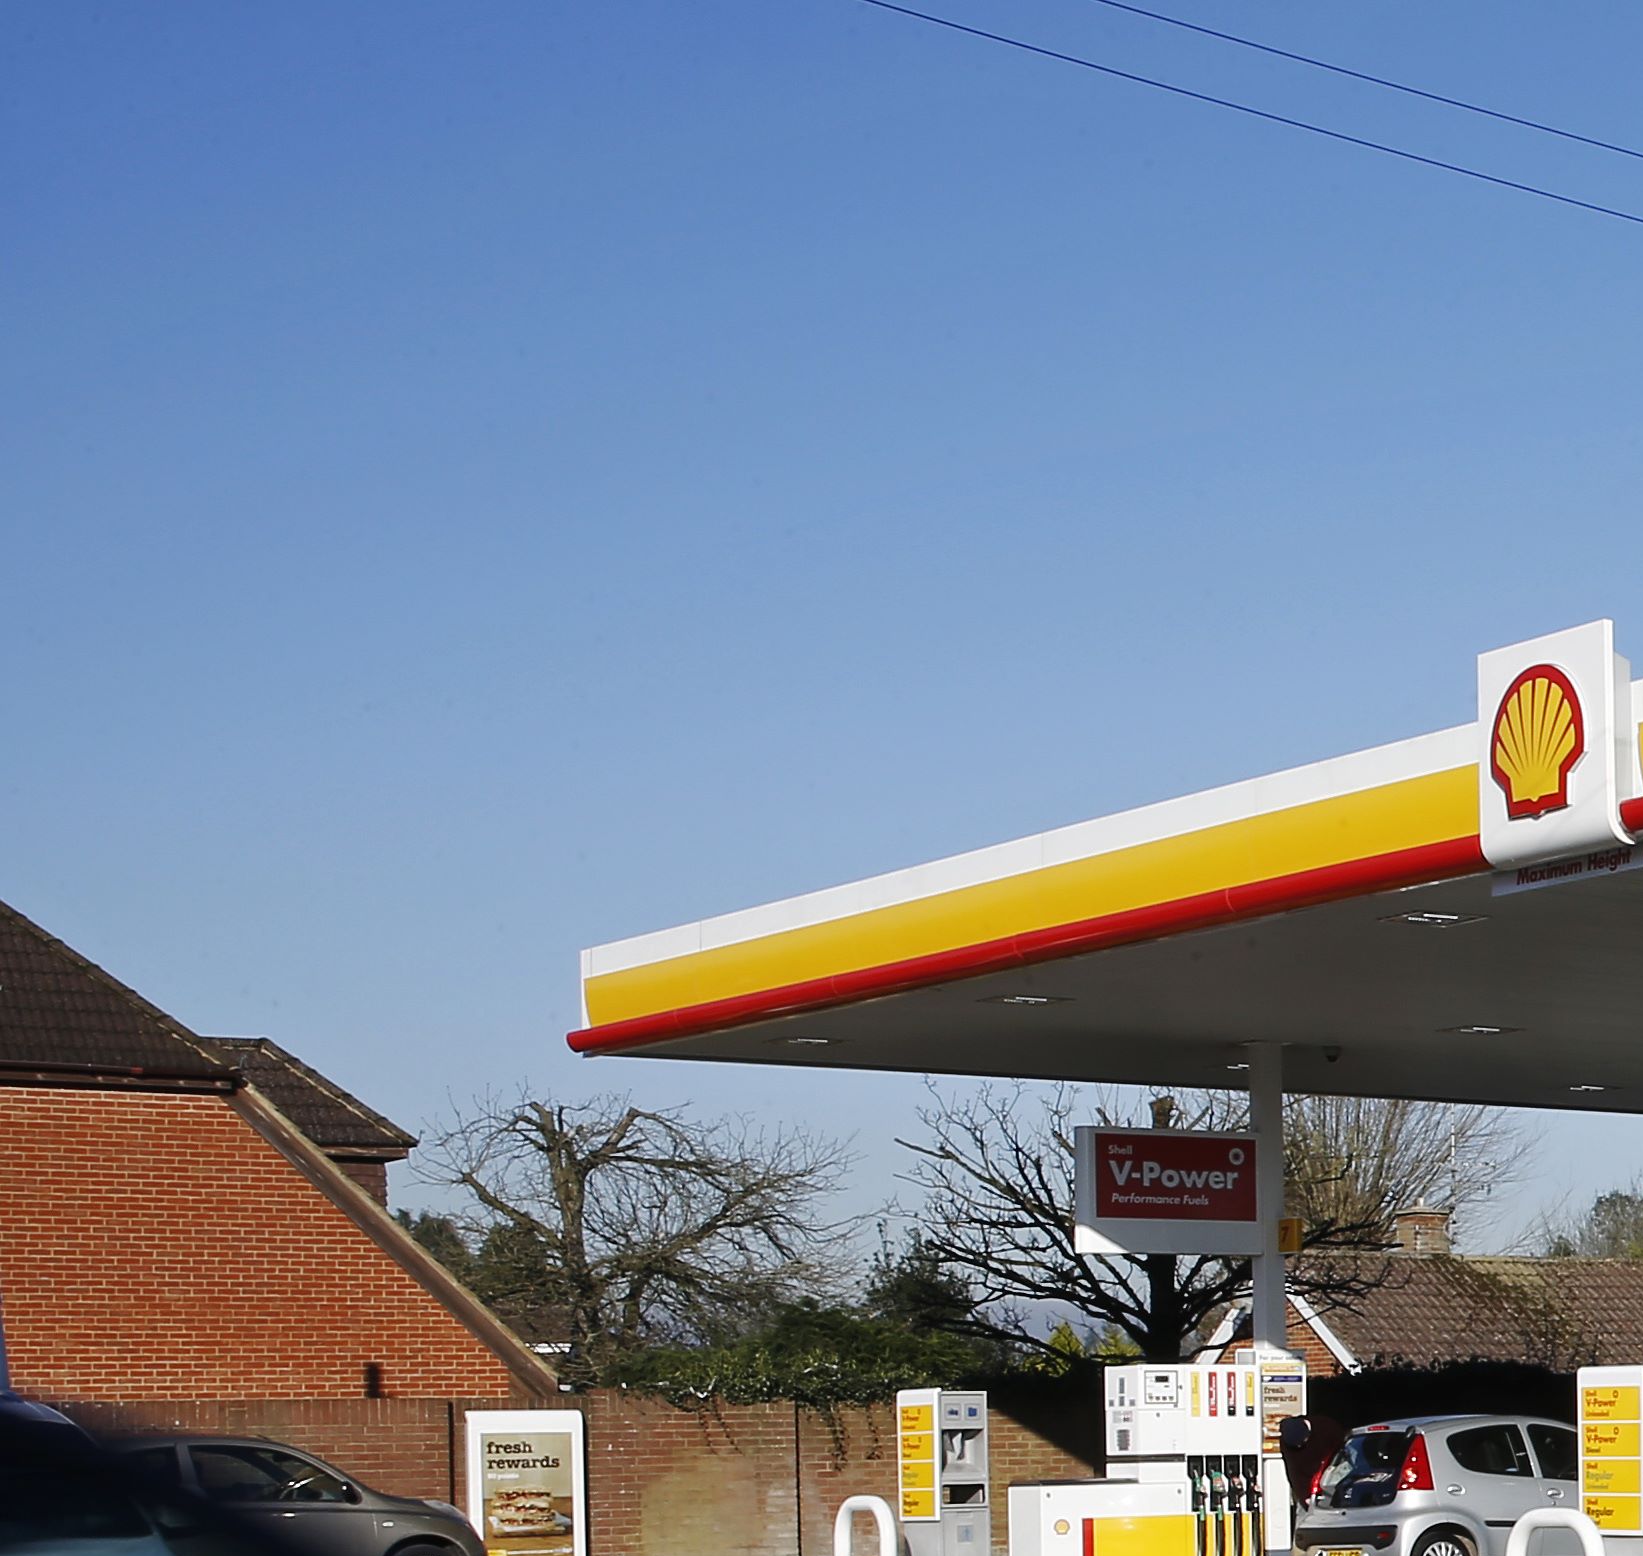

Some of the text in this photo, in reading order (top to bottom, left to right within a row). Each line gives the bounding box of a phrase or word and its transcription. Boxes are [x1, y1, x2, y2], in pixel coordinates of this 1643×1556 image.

[1517, 861, 1582, 885] Maximum
[1587, 850, 1632, 871] Height
[1108, 1145, 1133, 1155] Shell
[1109, 1160, 1239, 1190] V-Power
[1111, 1192, 1209, 1206] Performance Fuels
[1281, 1226, 1290, 1243] 7
[1264, 1386, 1285, 1394] fresh
[1585, 1398, 1616, 1407] V-Power
[1586, 1435, 1617, 1443] V-Power
[487, 1441, 533, 1454] fresh
[487, 1455, 560, 1469] rewards
[1586, 1507, 1614, 1518] Regular
